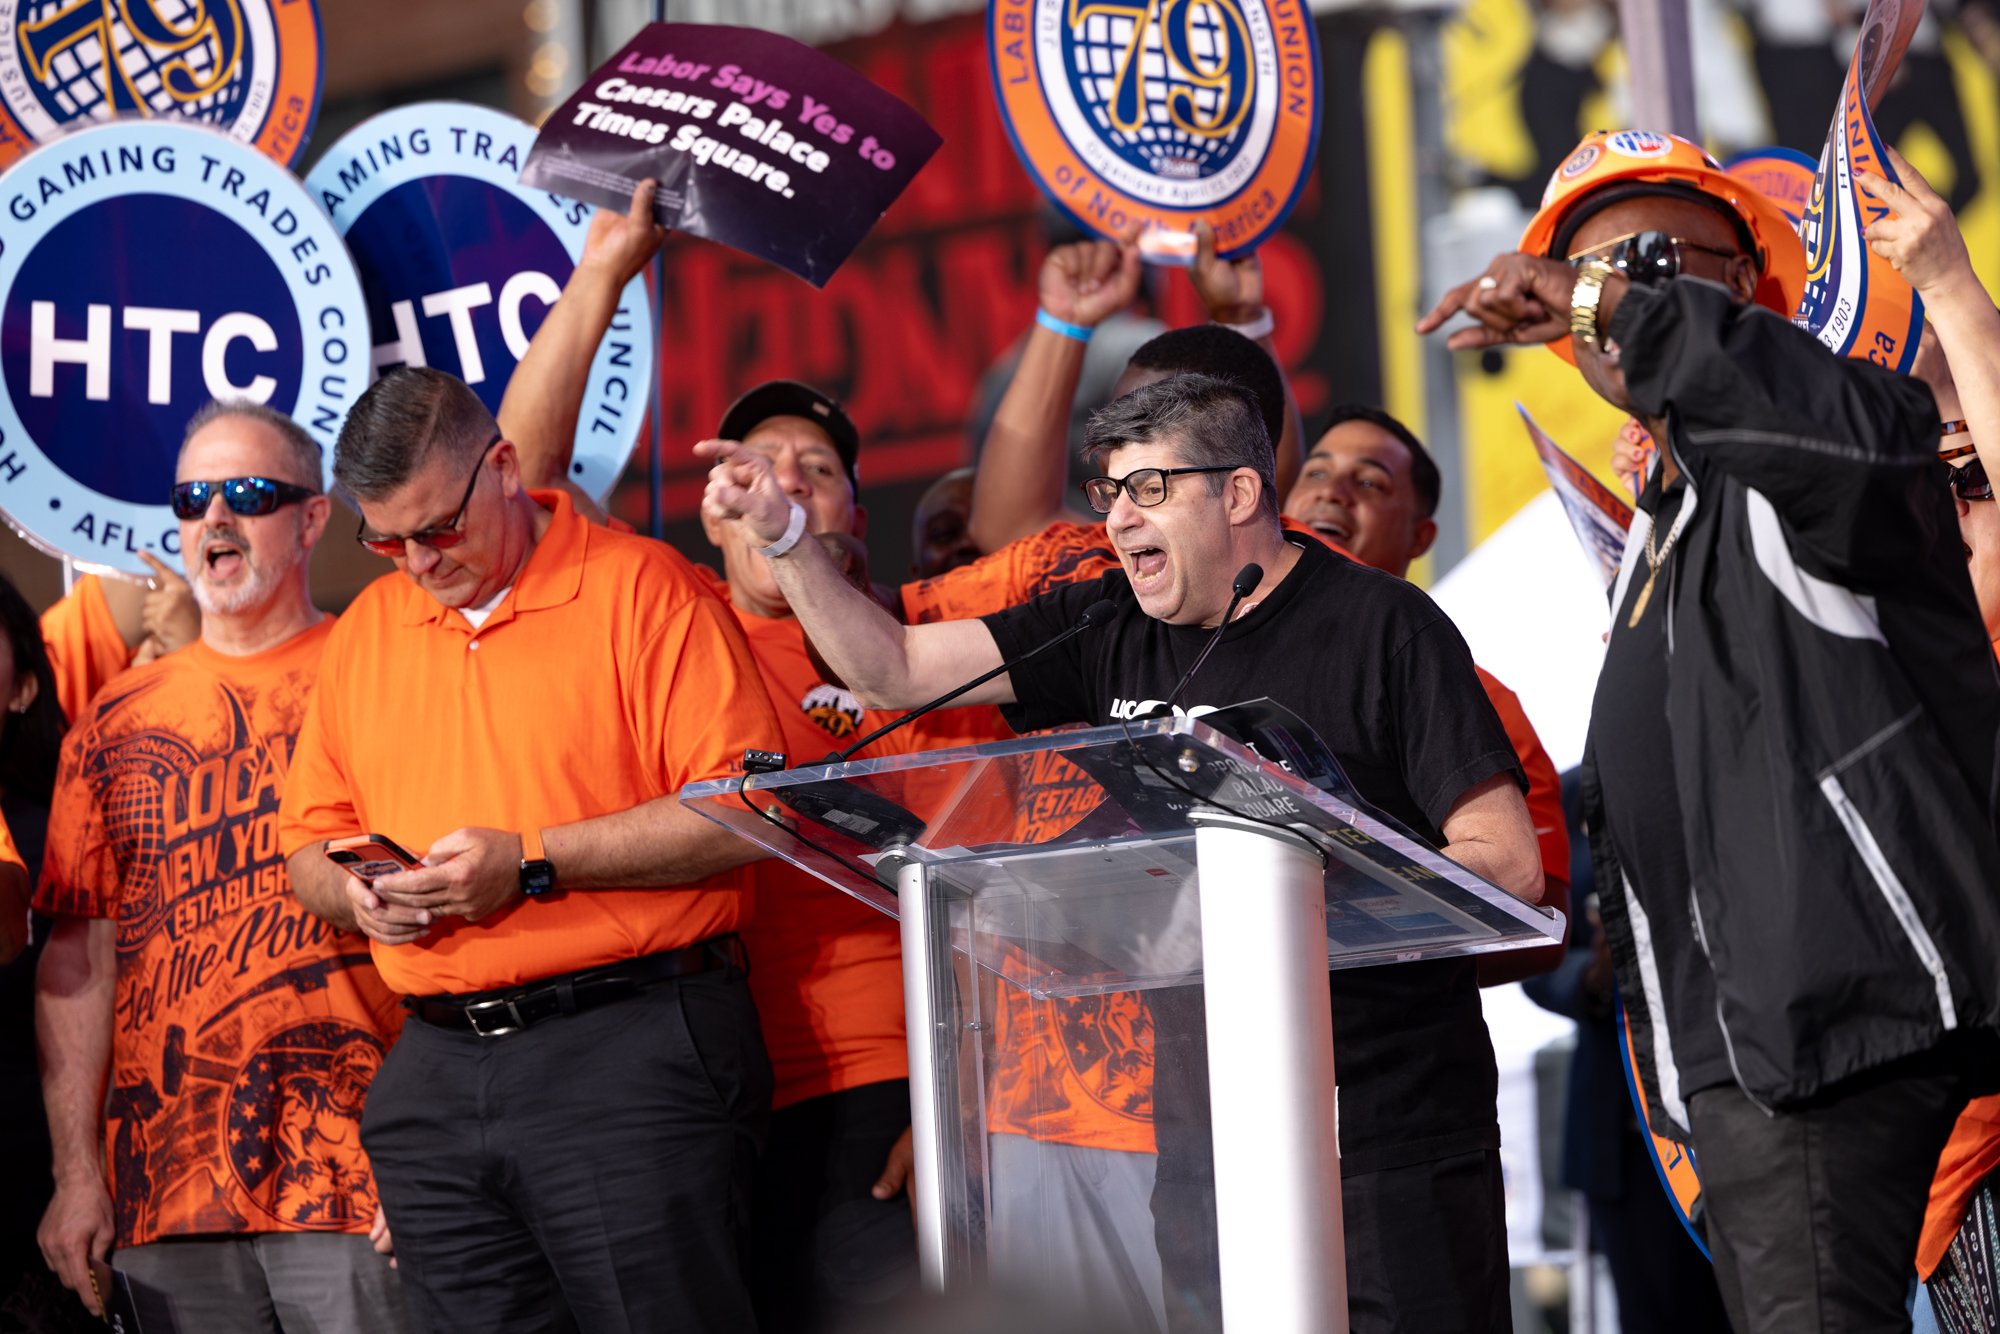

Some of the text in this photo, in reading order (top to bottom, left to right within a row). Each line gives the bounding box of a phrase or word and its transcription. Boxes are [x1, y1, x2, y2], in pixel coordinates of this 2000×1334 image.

[1069, 0, 1255, 138] 79
[1274, 0, 1308, 117] UNION
[571, 102, 671, 145] Times
[670, 125, 795, 200] Square.
[594, 77, 831, 174] Caesars Palace
[618, 51, 898, 172] Labor Says Yes to
[9, 147, 176, 222] GAMING
[200, 155, 331, 286] TRADES
[323, 128, 432, 216] AMING
[1055, 165, 1087, 195] of
[30, 300, 279, 405] HTC
[1831, 298, 1852, 338] 1903
[163, 735, 289, 844] LOCA
[157, 812, 280, 910] NEW YO
[174, 860, 293, 938] ESTABLISH
[166, 938, 224, 1009] the
